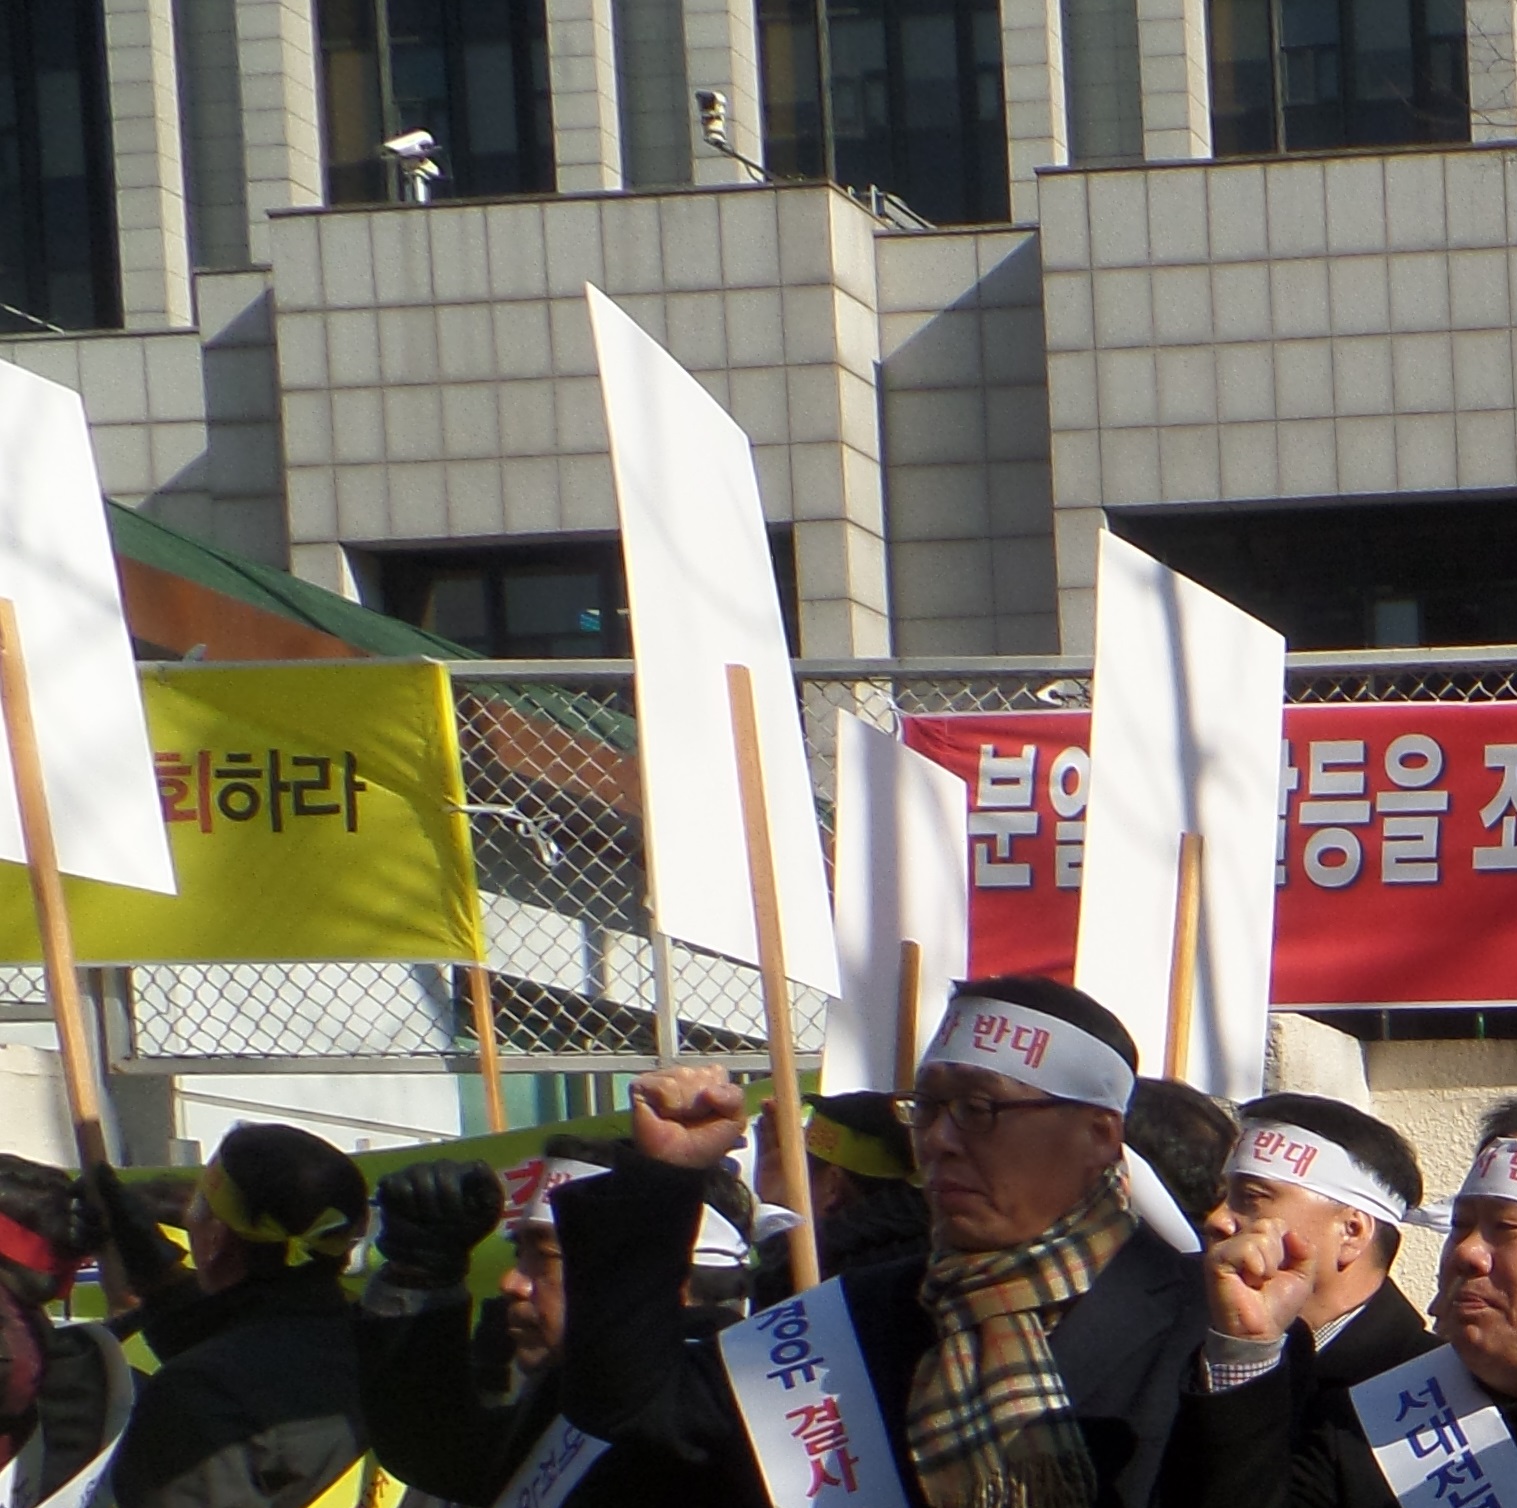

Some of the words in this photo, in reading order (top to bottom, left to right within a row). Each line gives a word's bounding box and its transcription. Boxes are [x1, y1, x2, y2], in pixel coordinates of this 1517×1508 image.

[1277, 734, 1450, 888] 등을
[972, 1013, 1052, 1069] 반대
[1253, 1131, 1319, 1177] 반대
[754, 1299, 825, 1390] 경유
[785, 1396, 860, 1499] 결사
